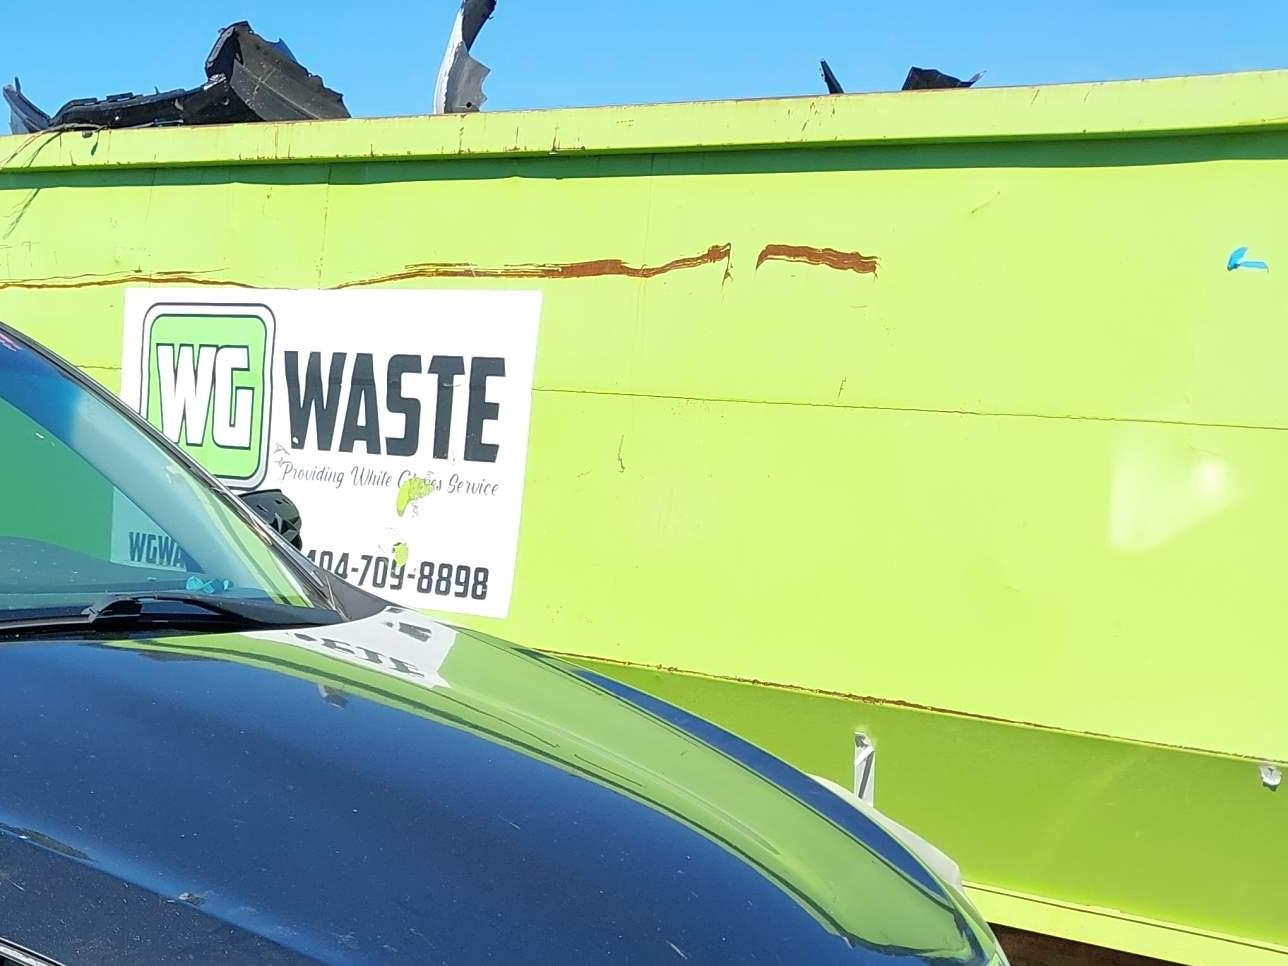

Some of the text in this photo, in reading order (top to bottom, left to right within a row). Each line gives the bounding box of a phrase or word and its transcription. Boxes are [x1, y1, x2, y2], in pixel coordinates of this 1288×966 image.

[156, 343, 255, 450] WG
[284, 350, 506, 463] WASTE
[280, 461, 345, 489] Providing
[350, 465, 392, 487] White
[447, 473, 500, 497] Service
